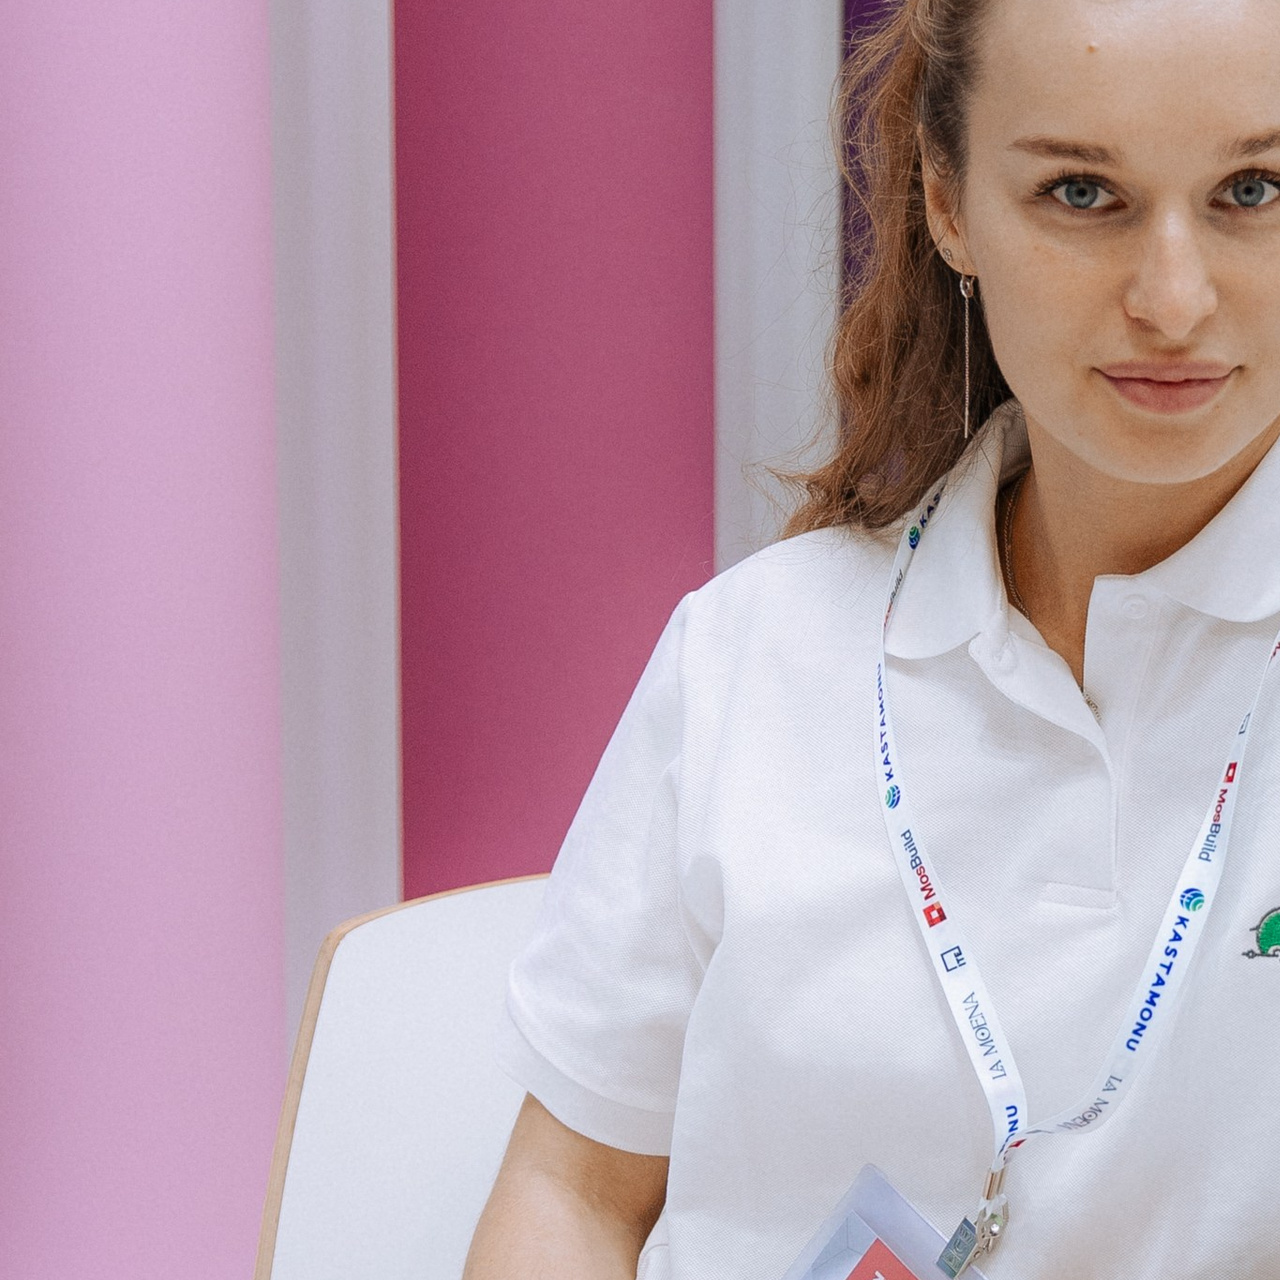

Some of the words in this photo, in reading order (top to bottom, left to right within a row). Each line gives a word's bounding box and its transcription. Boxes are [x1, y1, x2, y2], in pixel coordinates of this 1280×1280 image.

[1198, 788, 1228, 862] MosBuild
[901, 829, 936, 900] MosBuild
[1126, 915, 1189, 1052] KASTAMONU
[989, 1059, 1007, 1080] LA
[1102, 1075, 1122, 1092] LA
